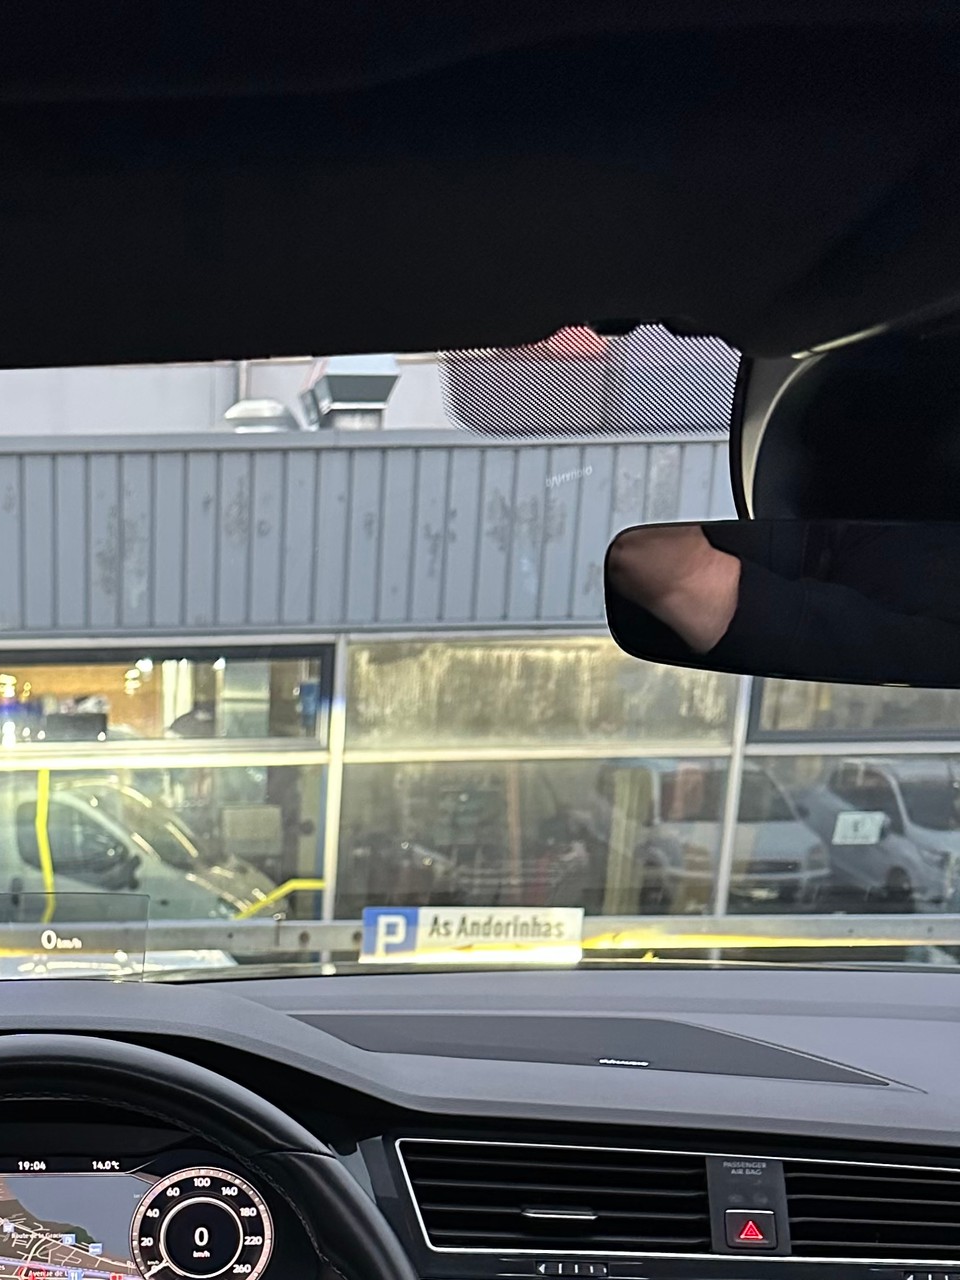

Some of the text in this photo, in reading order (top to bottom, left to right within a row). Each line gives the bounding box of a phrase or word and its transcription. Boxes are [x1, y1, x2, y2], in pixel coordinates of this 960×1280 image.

[428, 916, 450, 937] As
[456, 913, 565, 938] Andorinhas
[17, 1161, 46, 1171] 19:04
[193, 1178, 211, 1187] 100
[166, 1187, 180, 1197] 60
[221, 1186, 238, 1196] 140
[146, 1208, 160, 1218] 40
[239, 1207, 257, 1217] 180
[194, 1227, 209, 1246] 0
[244, 1236, 263, 1245] 220
[140, 1237, 154, 1247] 20
[233, 1264, 251, 1273] 260
